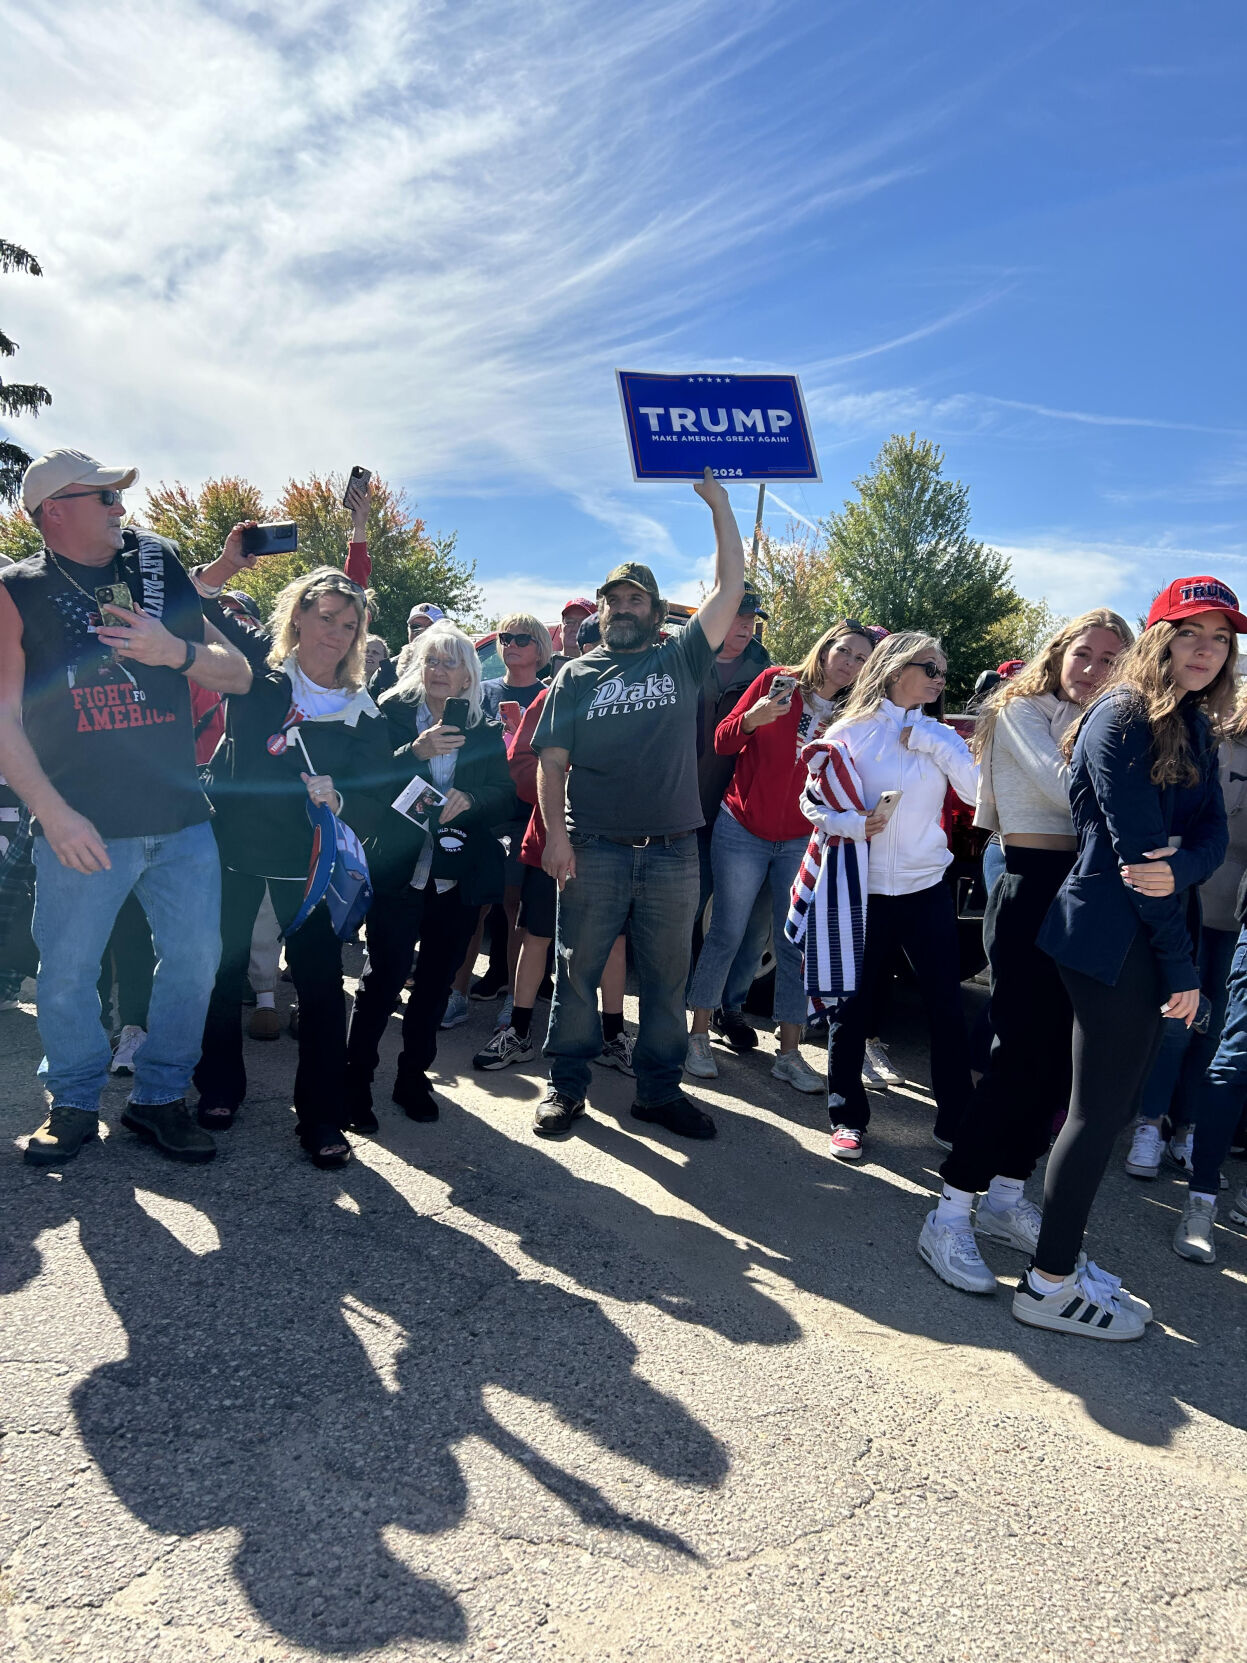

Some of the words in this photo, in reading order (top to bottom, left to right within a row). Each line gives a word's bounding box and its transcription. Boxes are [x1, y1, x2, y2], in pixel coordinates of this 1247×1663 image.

[639, 406, 793, 433] TRUMP
[726, 435, 755, 443] GREAT
[758, 435, 790, 443] AGAIN!
[712, 468, 743, 477] 2024
[138, 537, 164, 618] ARLEY-DAVI
[71, 682, 134, 710] FIGHT
[133, 690, 147, 702] FO
[590, 673, 675, 709] Drake
[586, 695, 677, 720] BULLDOGS
